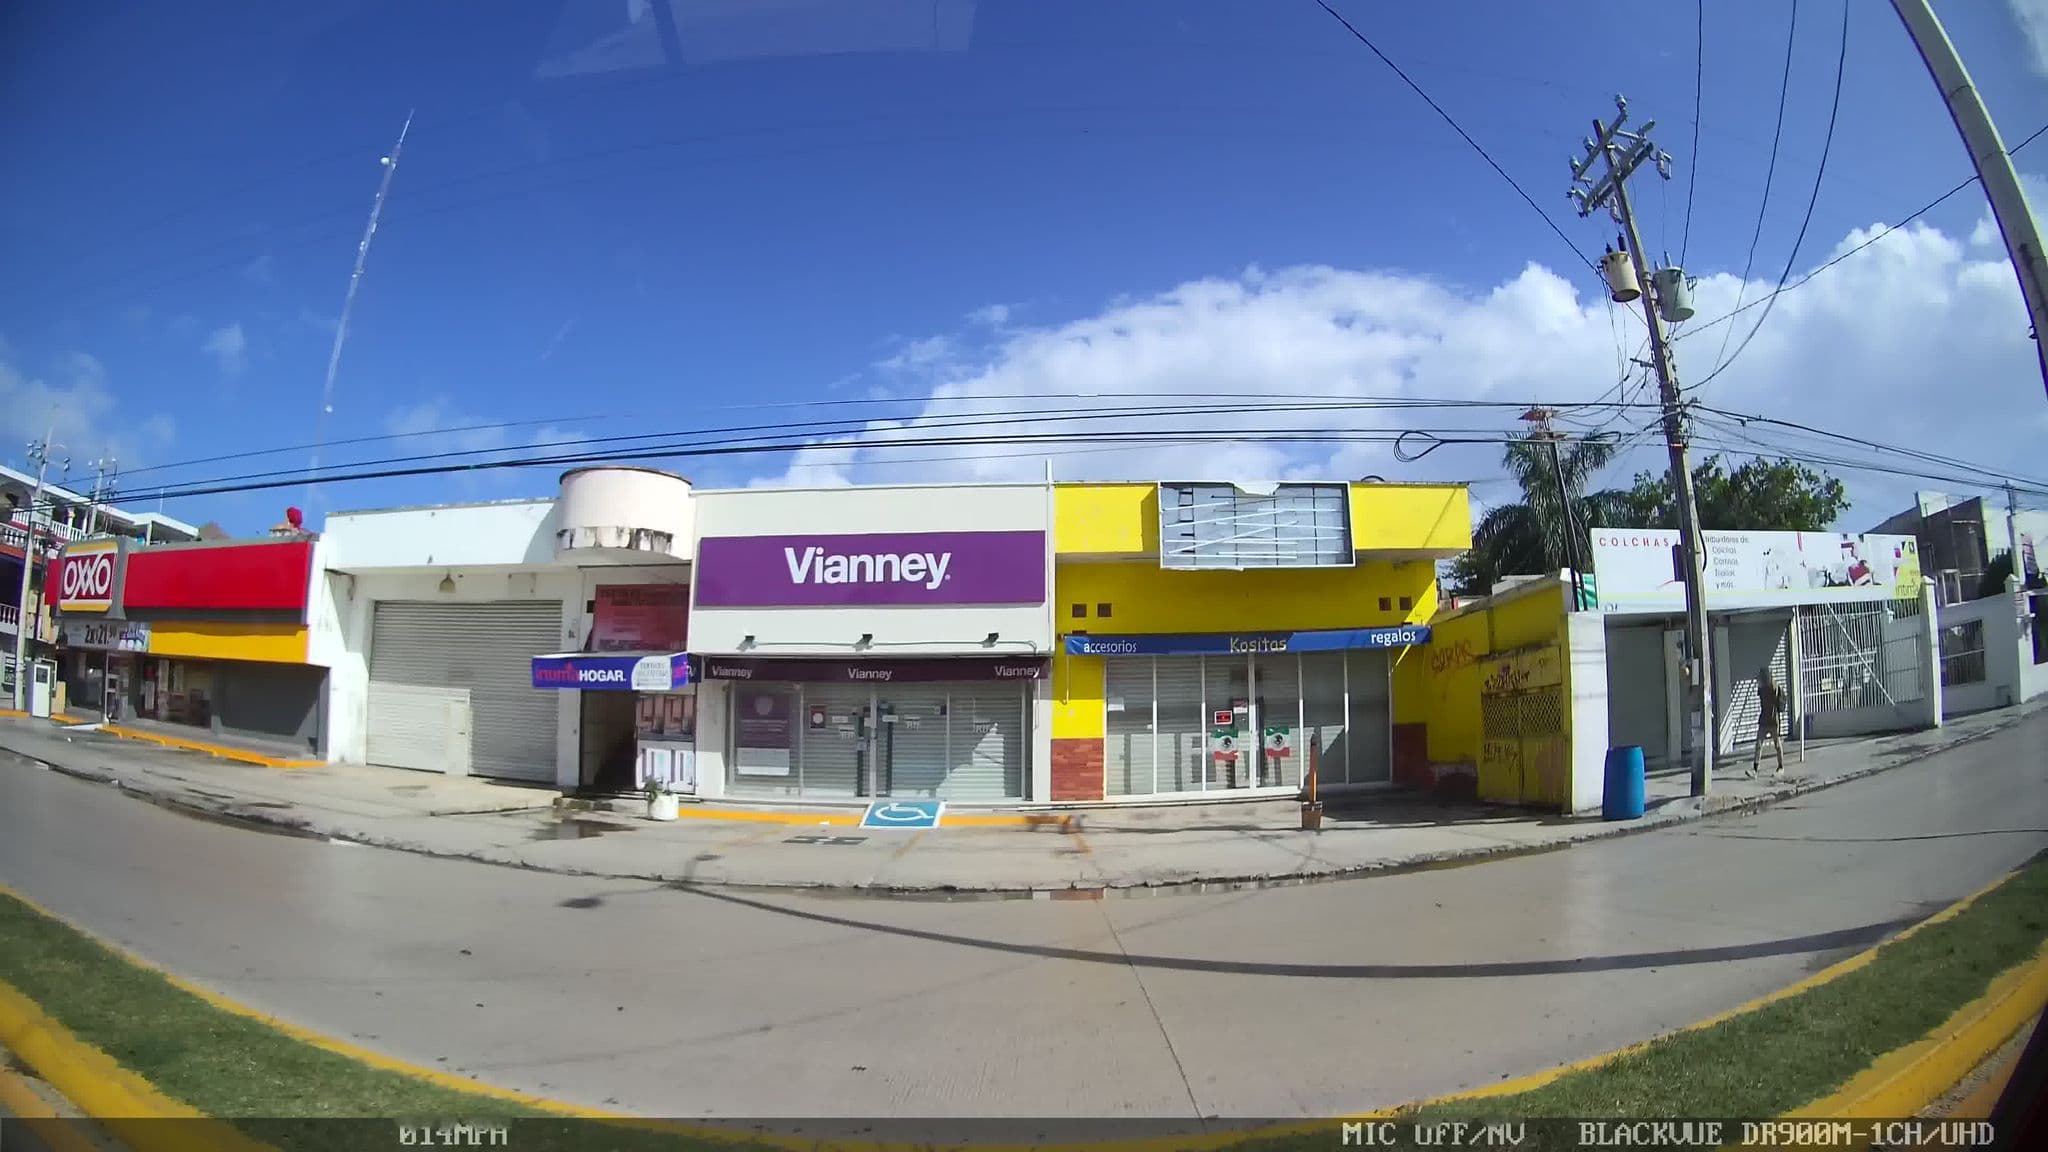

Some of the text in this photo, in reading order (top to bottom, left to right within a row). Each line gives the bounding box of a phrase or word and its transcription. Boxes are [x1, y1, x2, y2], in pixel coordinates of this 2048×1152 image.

[1599, 537, 1669, 547] COLCHAS
[784, 547, 951, 589] Vianney
[63, 553, 111, 600] OXXO
[1371, 630, 1416, 646] regalos
[1083, 641, 1137, 653] accesorios
[712, 665, 752, 679] Vianney
[848, 668, 892, 681] Vianney
[994, 665, 1040, 678] Vianney
